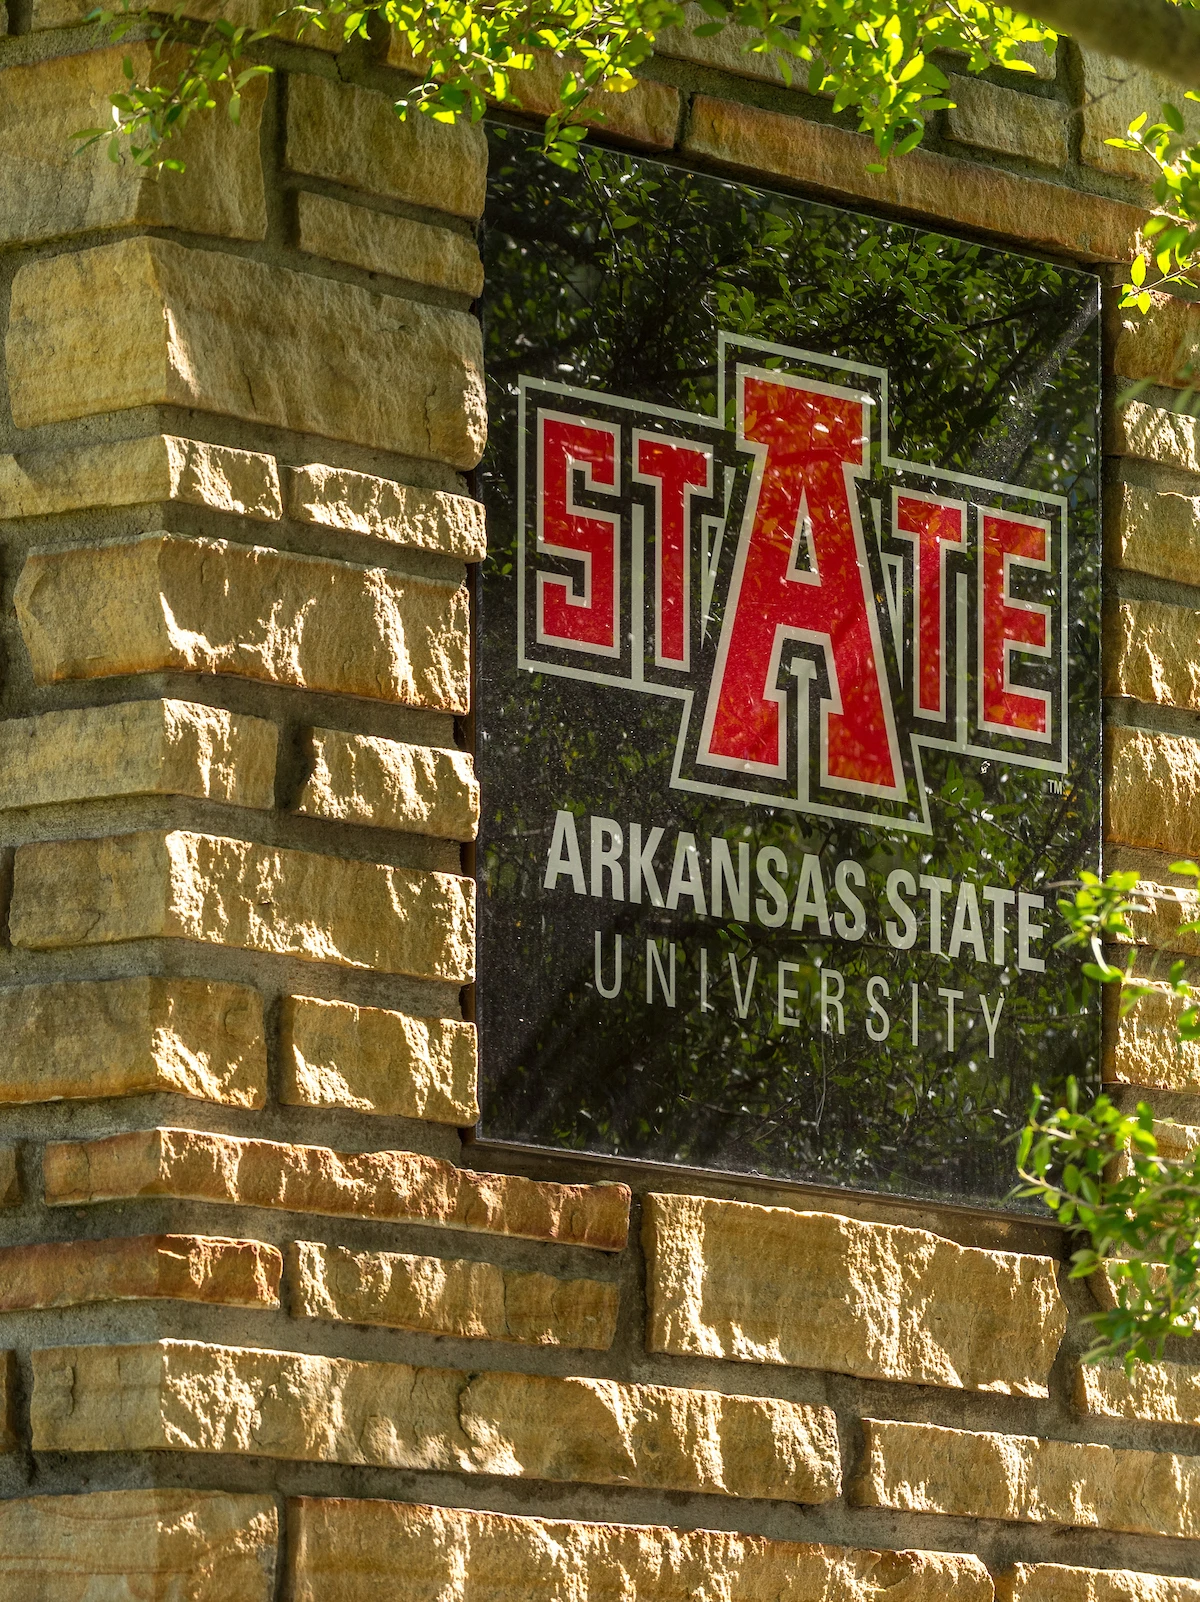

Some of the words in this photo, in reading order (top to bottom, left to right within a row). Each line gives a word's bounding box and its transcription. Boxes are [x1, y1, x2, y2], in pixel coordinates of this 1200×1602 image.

[517, 329, 1069, 836] STATE
[543, 809, 867, 941] ARKANSAS
[885, 868, 1045, 973] STATE
[594, 930, 1005, 1059] UNIVERSITY
